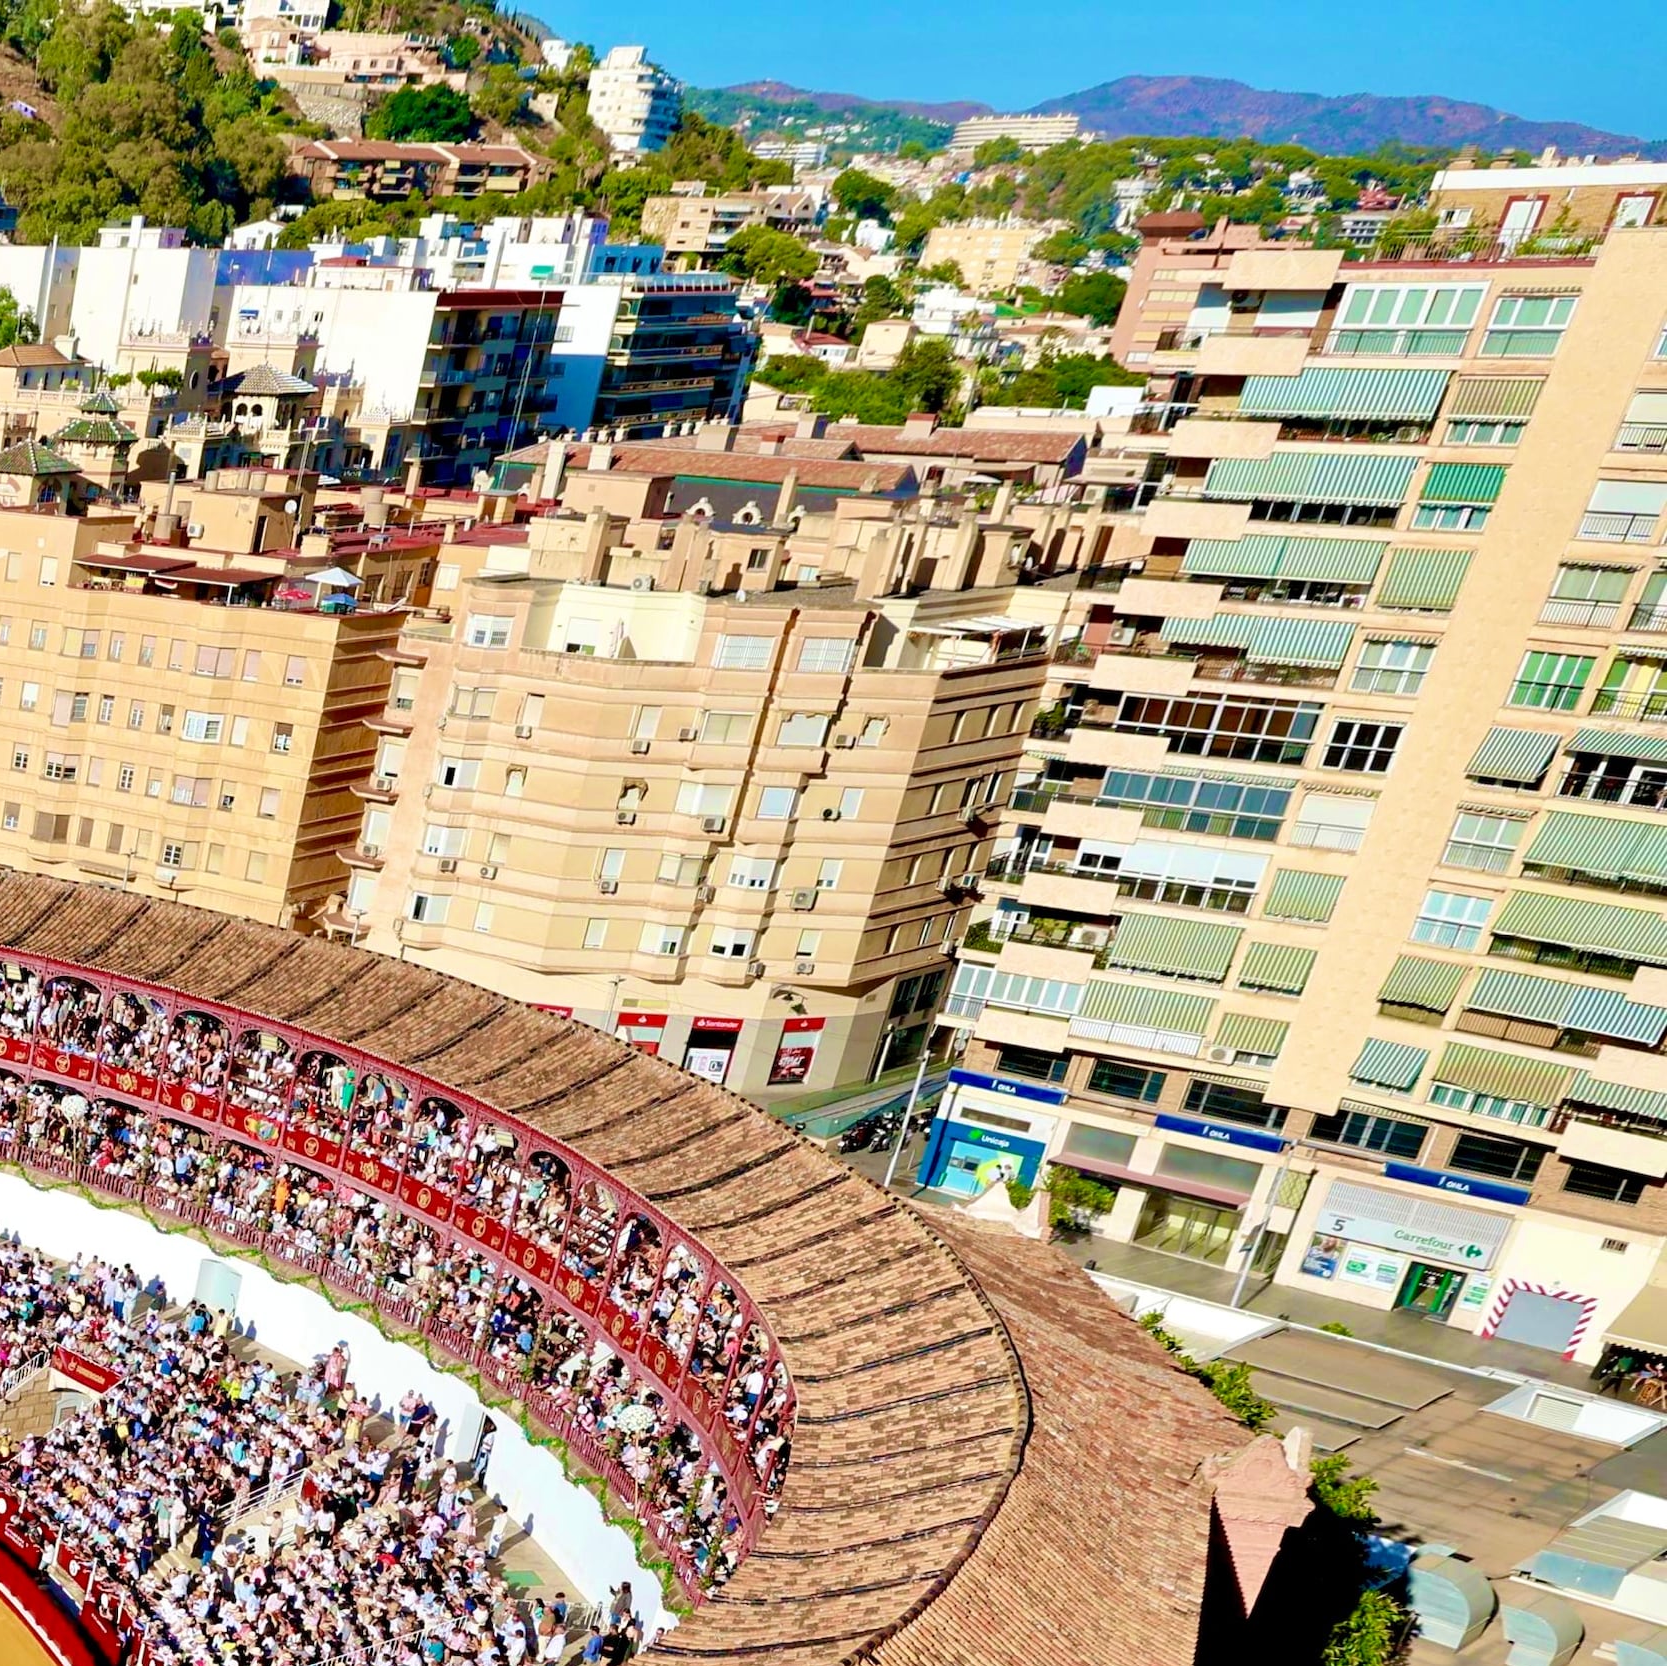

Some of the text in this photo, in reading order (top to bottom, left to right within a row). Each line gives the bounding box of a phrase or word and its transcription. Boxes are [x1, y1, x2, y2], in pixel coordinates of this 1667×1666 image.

[705, 1019, 740, 1028] Santander
[981, 1134, 1010, 1148] Unicaja
[1332, 1218, 1346, 1232] 5
[1394, 1228, 1455, 1251] Carrefour
